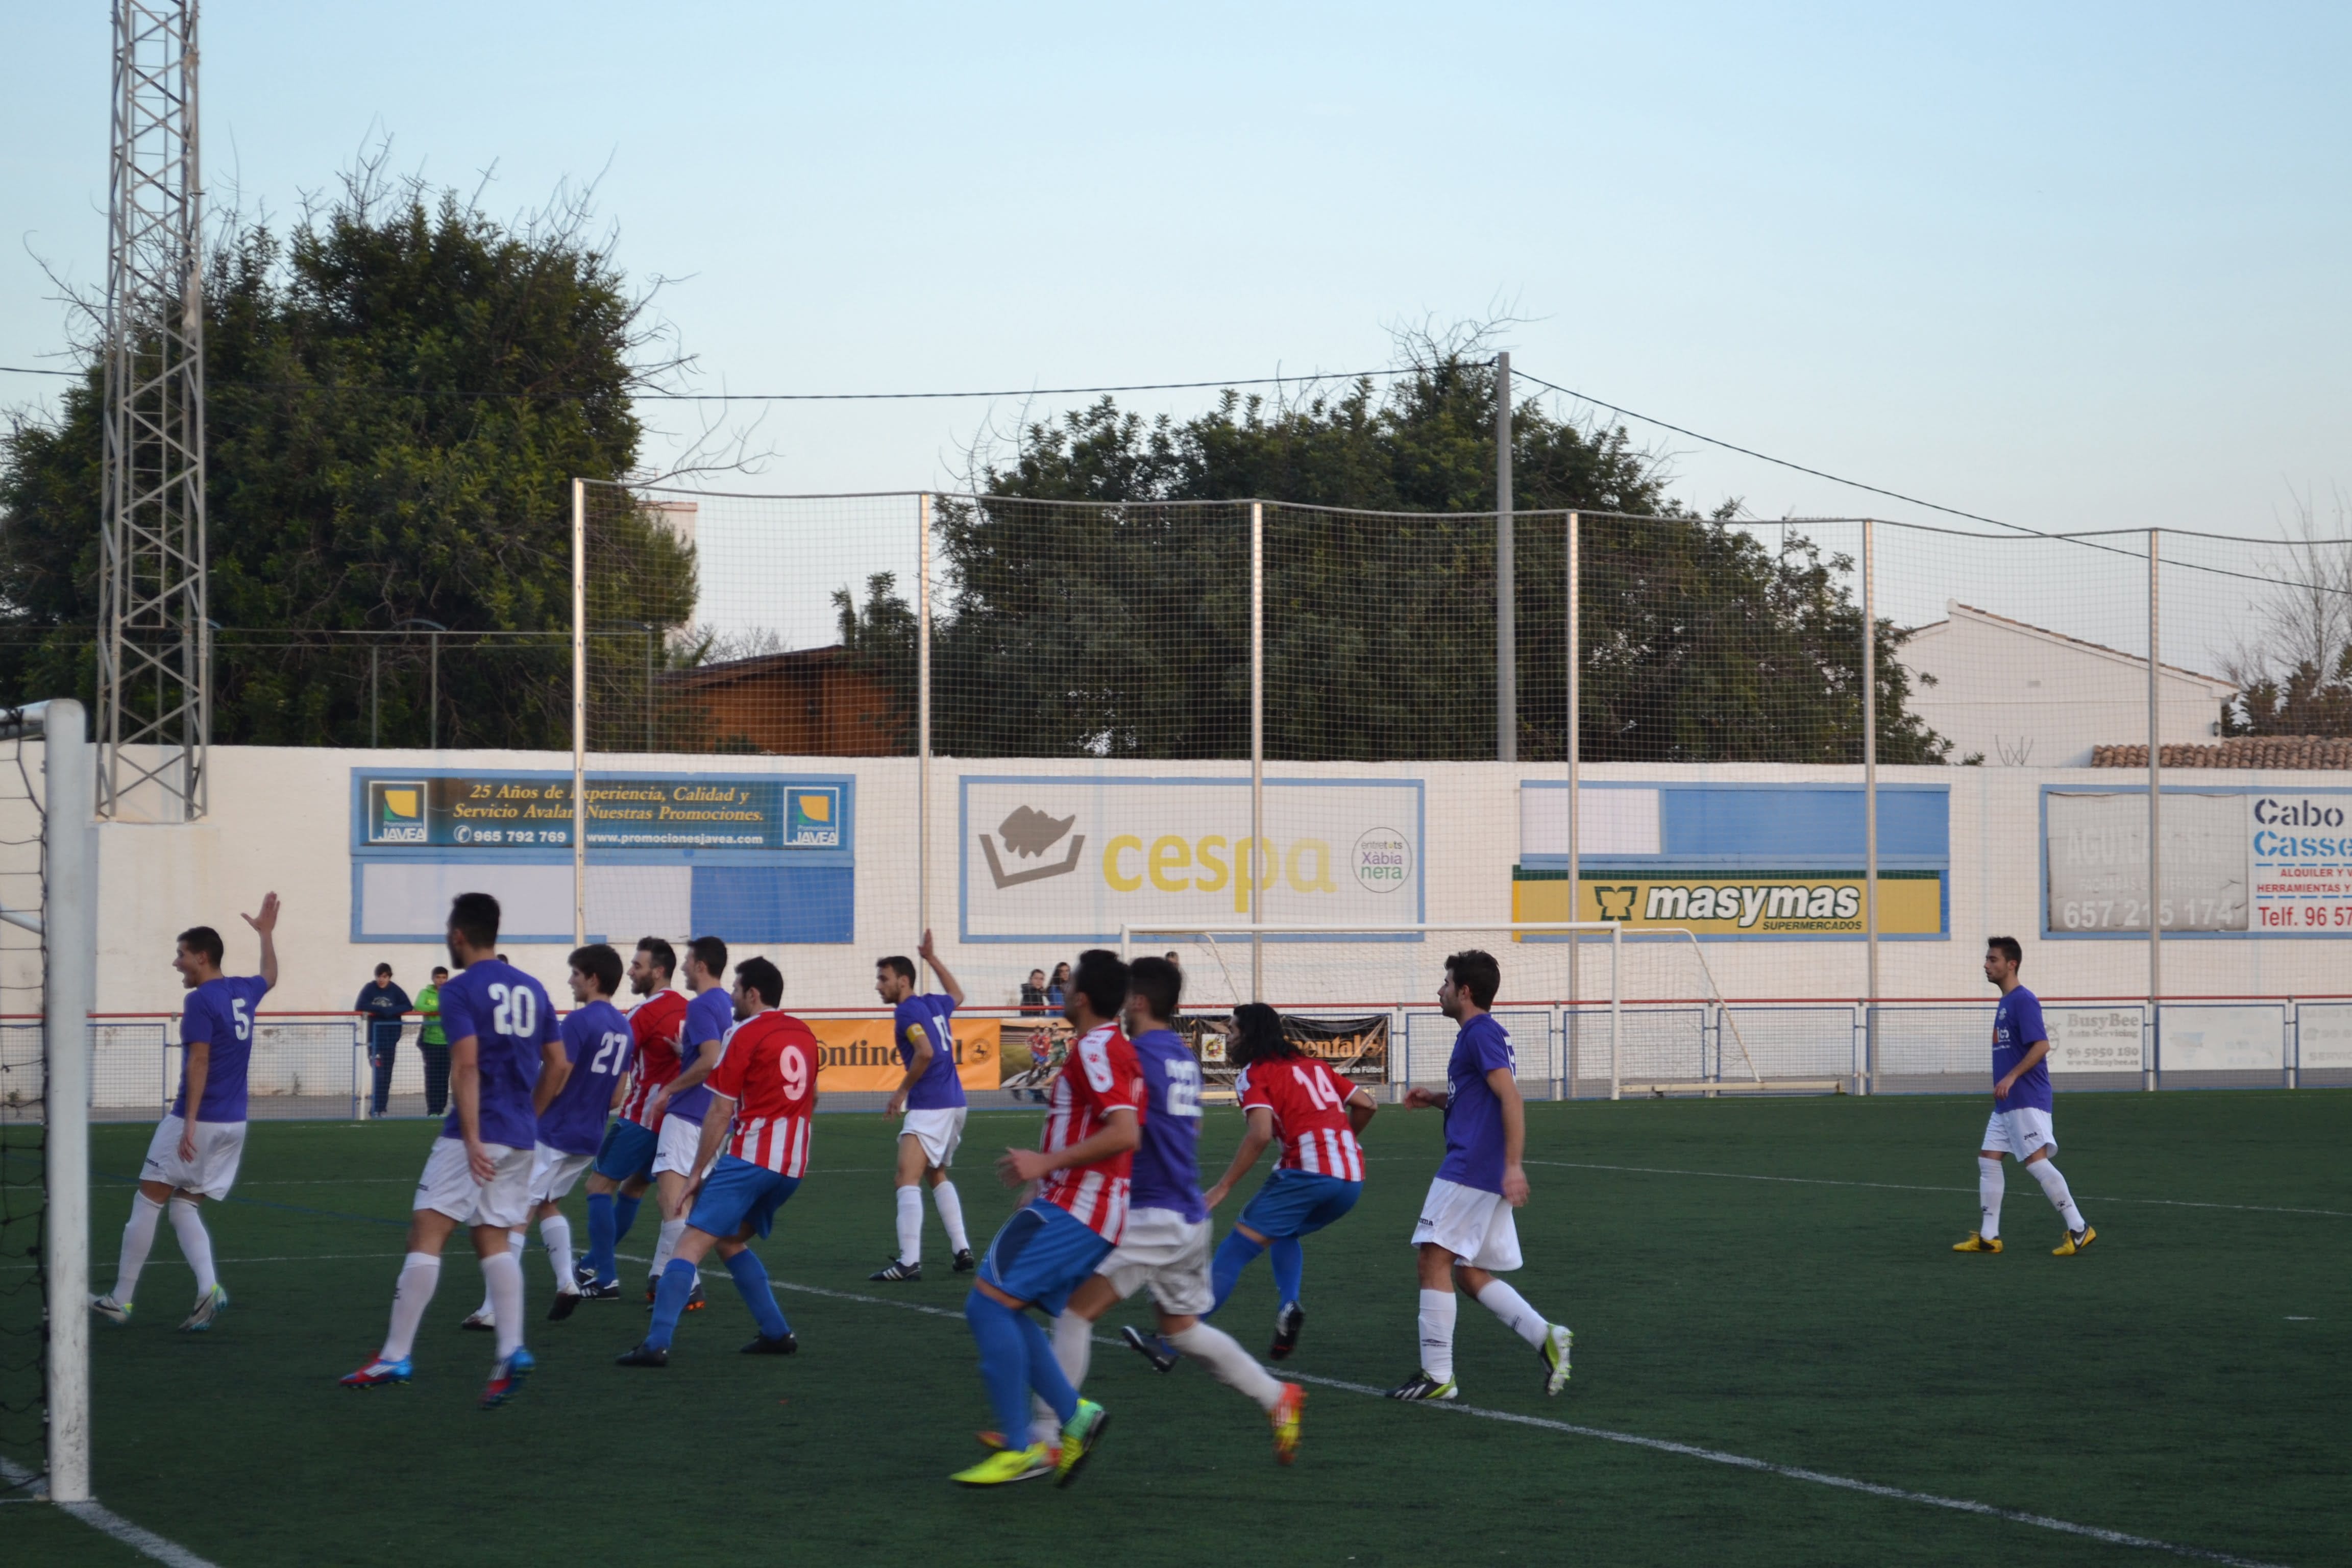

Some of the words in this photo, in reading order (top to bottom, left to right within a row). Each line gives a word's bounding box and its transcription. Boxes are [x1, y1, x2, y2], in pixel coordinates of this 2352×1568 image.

[470, 785, 492, 798] 25
[496, 784, 538, 799] Años
[544, 785, 564, 799] de
[569, 785, 666, 804] xperiencia,
[673, 787, 734, 801] Calidad
[739, 791, 750, 805] y
[453, 803, 518, 818] Servicio
[584, 805, 653, 820] Nuestras
[659, 806, 764, 821] Promociones.
[2255, 799, 2344, 827] Cabo
[474, 831, 502, 842] 965
[506, 831, 534, 842] 792
[539, 831, 567, 843] 769
[586, 832, 764, 845] www.promocionesjavea.com
[1362, 851, 1403, 865] Xàbia
[1102, 834, 1338, 913] cespa
[2281, 868, 2333, 877] ALQUILER
[2337, 868, 2344, 876] Y
[2257, 884, 2341, 892] HERRAMIENTAS
[1644, 885, 1861, 928] masymas
[2063, 900, 2115, 928] 657
[2184, 898, 2234, 925] 174
[2258, 906, 2298, 926] Telf.
[2305, 906, 2327, 926] 96
[1762, 920, 1863, 930] SUPERMERCADOS
[231, 997, 250, 1041] 5
[488, 983, 536, 1038] 20
[2067, 1013, 2139, 1030] BusyBee
[591, 1032, 628, 1076] 27
[2084, 1048, 2113, 1057] 5050
[2117, 1047, 2139, 1056] 180
[779, 1045, 808, 1101] 9
[1292, 1065, 1345, 1113] 14
